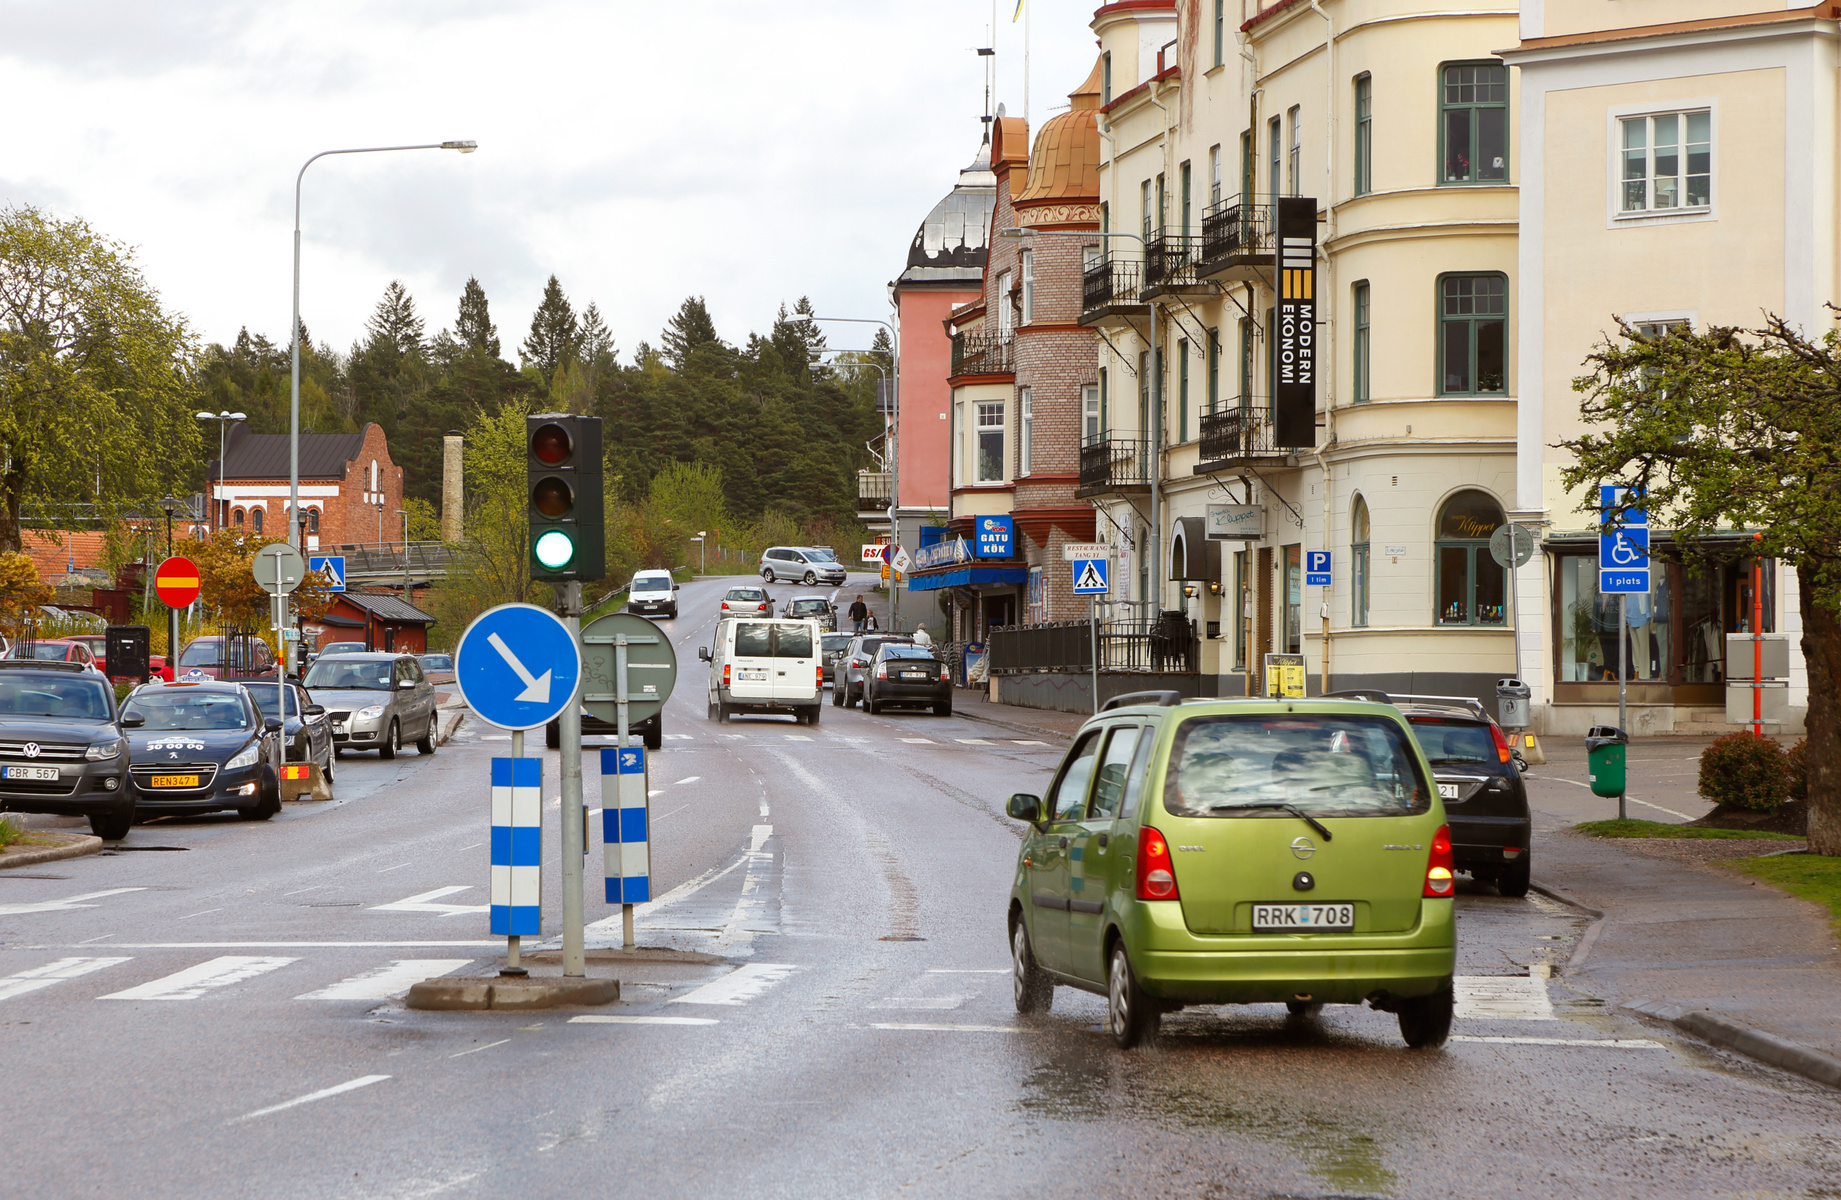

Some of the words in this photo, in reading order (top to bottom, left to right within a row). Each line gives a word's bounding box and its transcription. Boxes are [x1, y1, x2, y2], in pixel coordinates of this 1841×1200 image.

[1281, 304, 1295, 384] EKONOMI
[1299, 304, 1312, 384] MODERN
[1216, 510, 1255, 526] Klippet
[1454, 516, 1495, 537] Klippet
[981, 534, 1008, 542] GATU
[864, 548, 883, 558] GS/
[983, 544, 1005, 553] KÖK
[1313, 553, 1326, 571] P
[1609, 577, 1613, 585] 1
[1616, 577, 1641, 587] plats
[9, 768, 29, 777] CBR
[36, 769, 56, 779] 567
[1438, 785, 1455, 796] 21
[1257, 907, 1297, 925] RRK
[1312, 907, 1351, 925] 708
